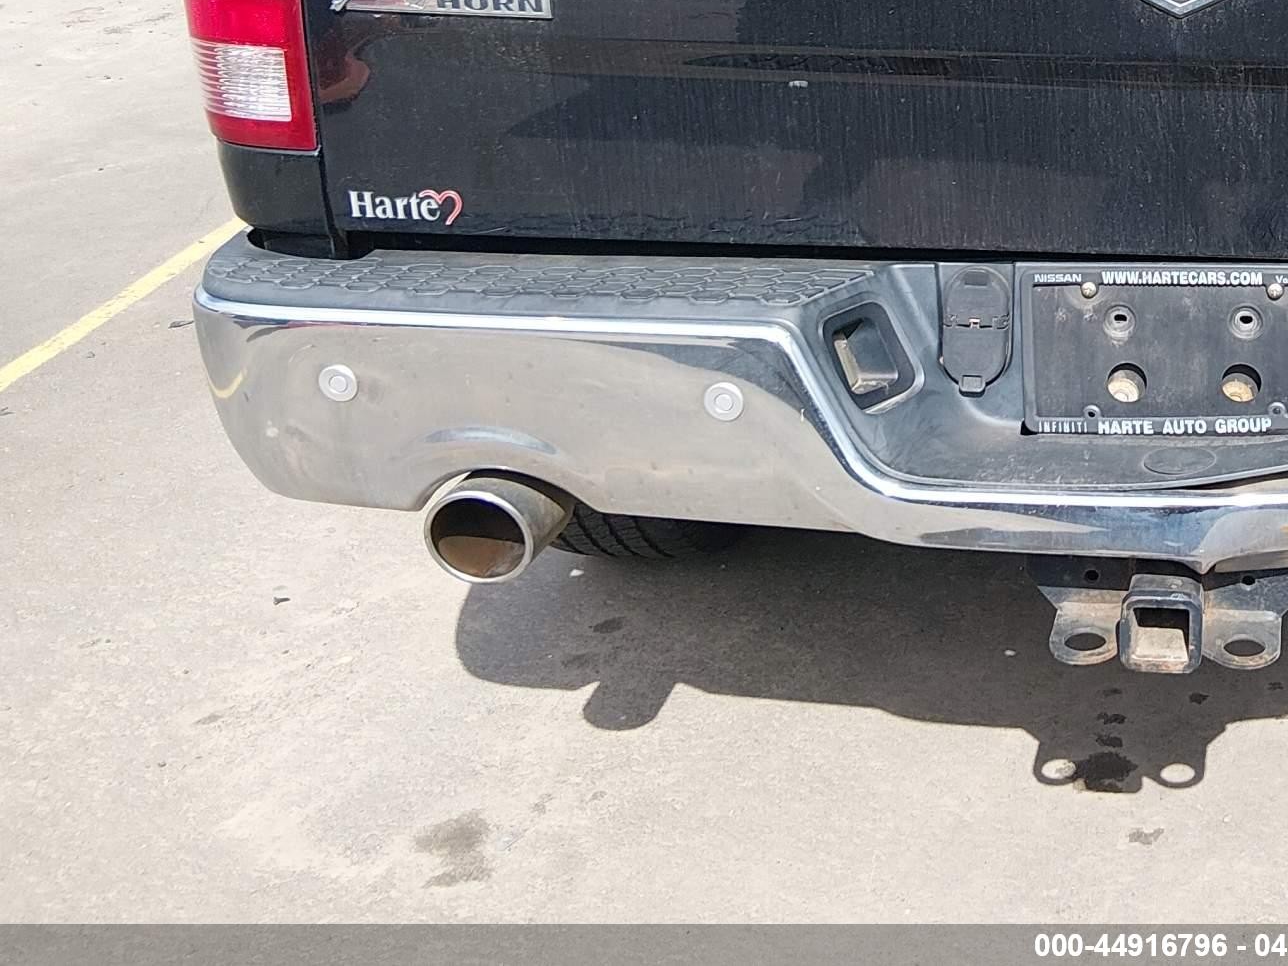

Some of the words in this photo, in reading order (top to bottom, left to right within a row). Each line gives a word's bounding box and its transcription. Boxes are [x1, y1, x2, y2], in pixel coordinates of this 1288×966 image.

[349, 190, 441, 220] Harte
[1034, 273, 1082, 283] NISSAN
[1101, 271, 1263, 285] WWW.HARTECARS.COM
[1038, 420, 1088, 433] INFINITI
[1098, 420, 1154, 434] HARTE
[1162, 419, 1208, 434] AUTO
[1215, 418, 1272, 434] GROUP
